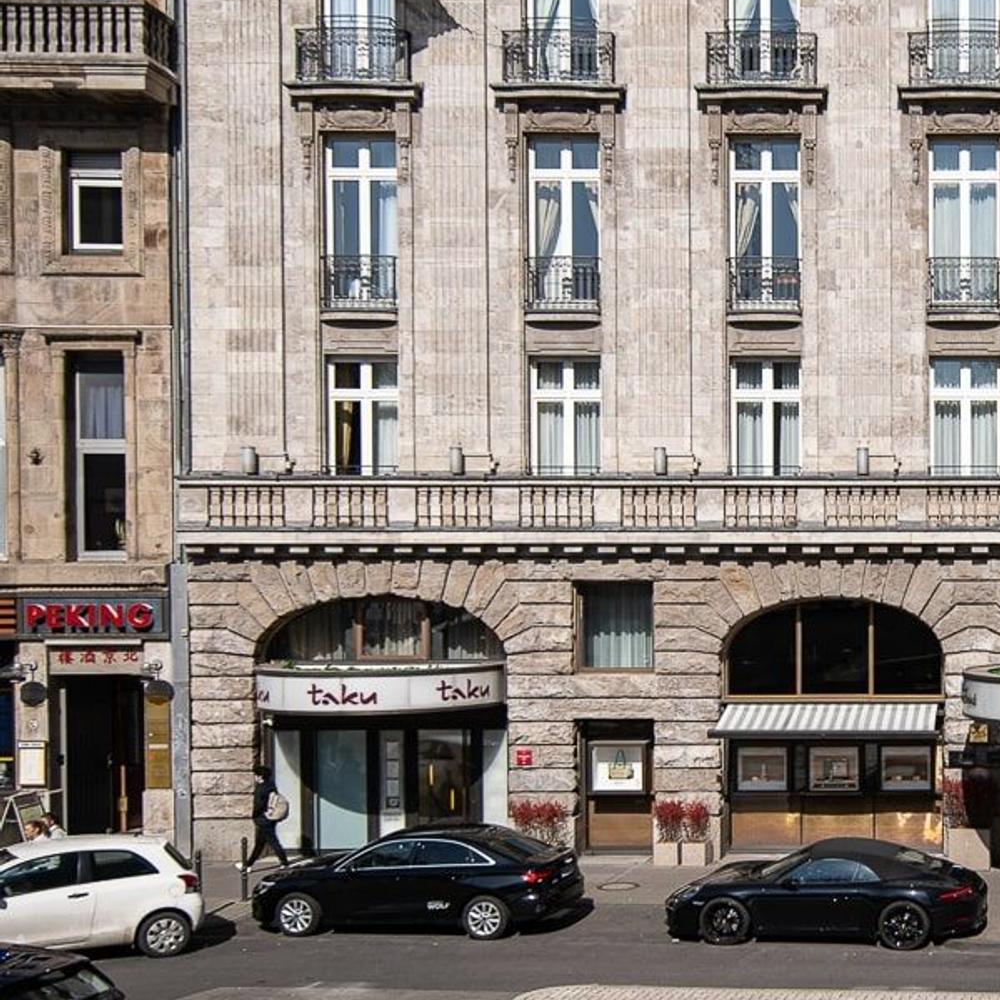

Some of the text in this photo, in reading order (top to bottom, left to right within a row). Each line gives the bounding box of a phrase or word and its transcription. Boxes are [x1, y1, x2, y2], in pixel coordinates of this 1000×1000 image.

[26, 602, 154, 629] PEKING
[307, 683, 378, 706] taku
[436, 679, 490, 701] taku
